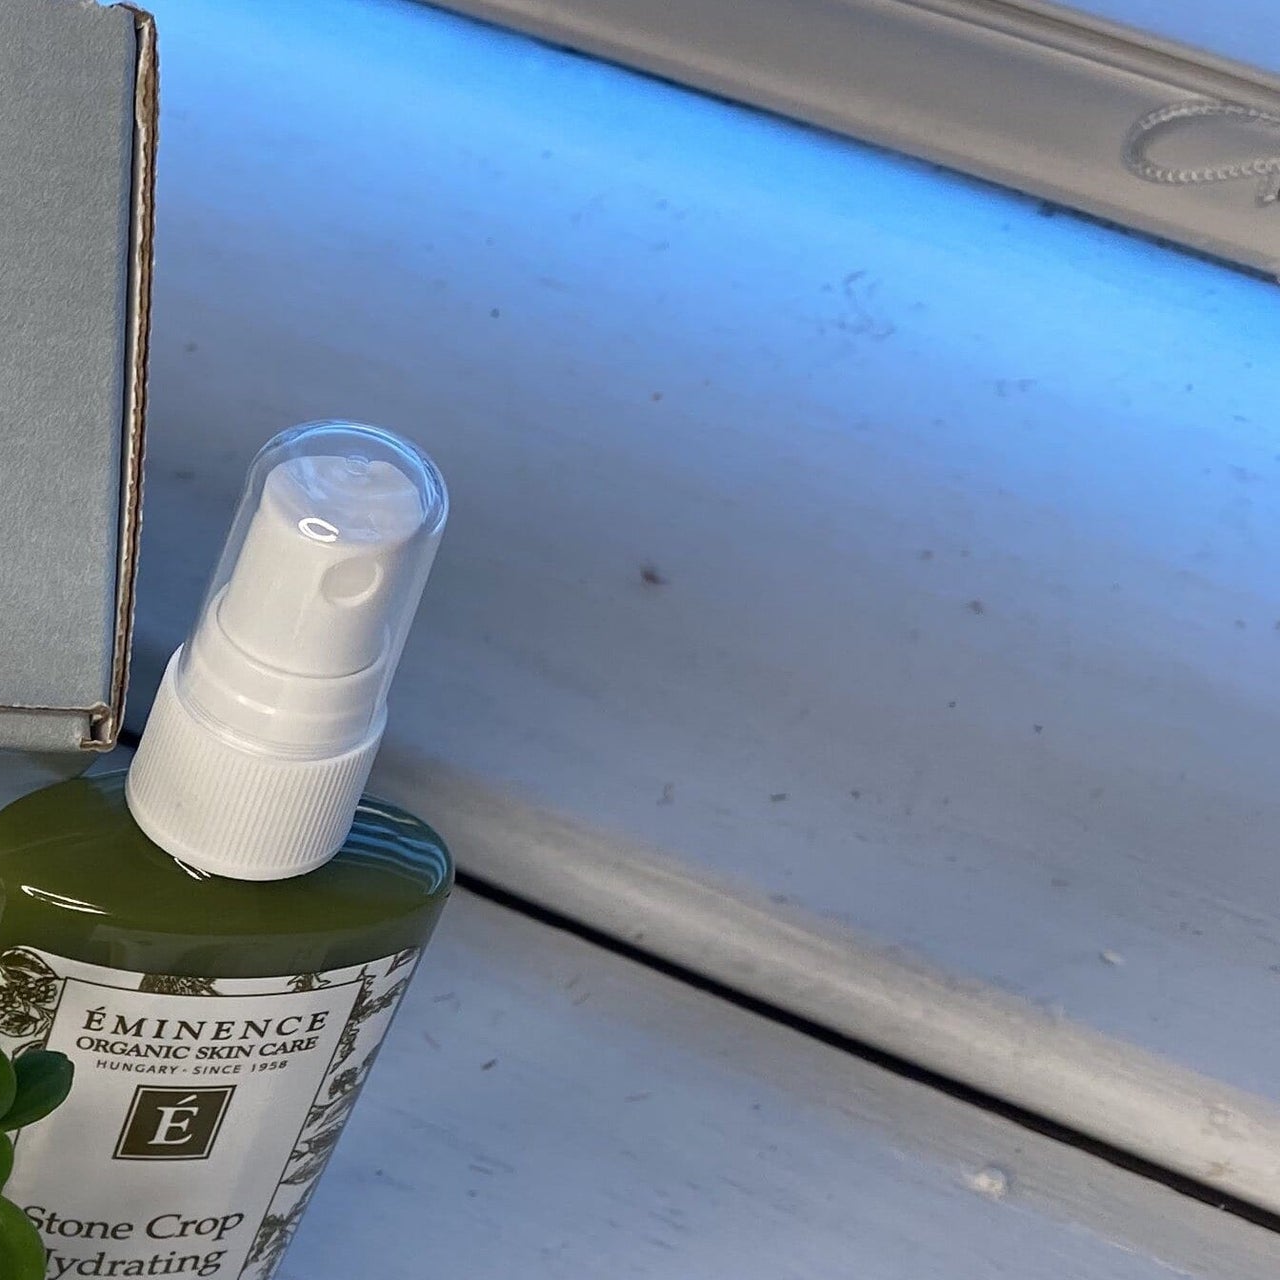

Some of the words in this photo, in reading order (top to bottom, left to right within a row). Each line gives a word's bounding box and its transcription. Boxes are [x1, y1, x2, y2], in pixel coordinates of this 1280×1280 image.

[82, 1006, 330, 1041] ÉMINENCE
[75, 1036, 191, 1060] ORGANIC
[195, 1044, 254, 1060] SKIN
[259, 1036, 320, 1056] CARE
[96, 1060, 180, 1075] HUNGARY
[192, 1064, 242, 1075] SINCE
[251, 1060, 288, 1073] 1958
[147, 1094, 199, 1145] É
[23, 1205, 134, 1240] Stone
[145, 1212, 245, 1241] Crop
